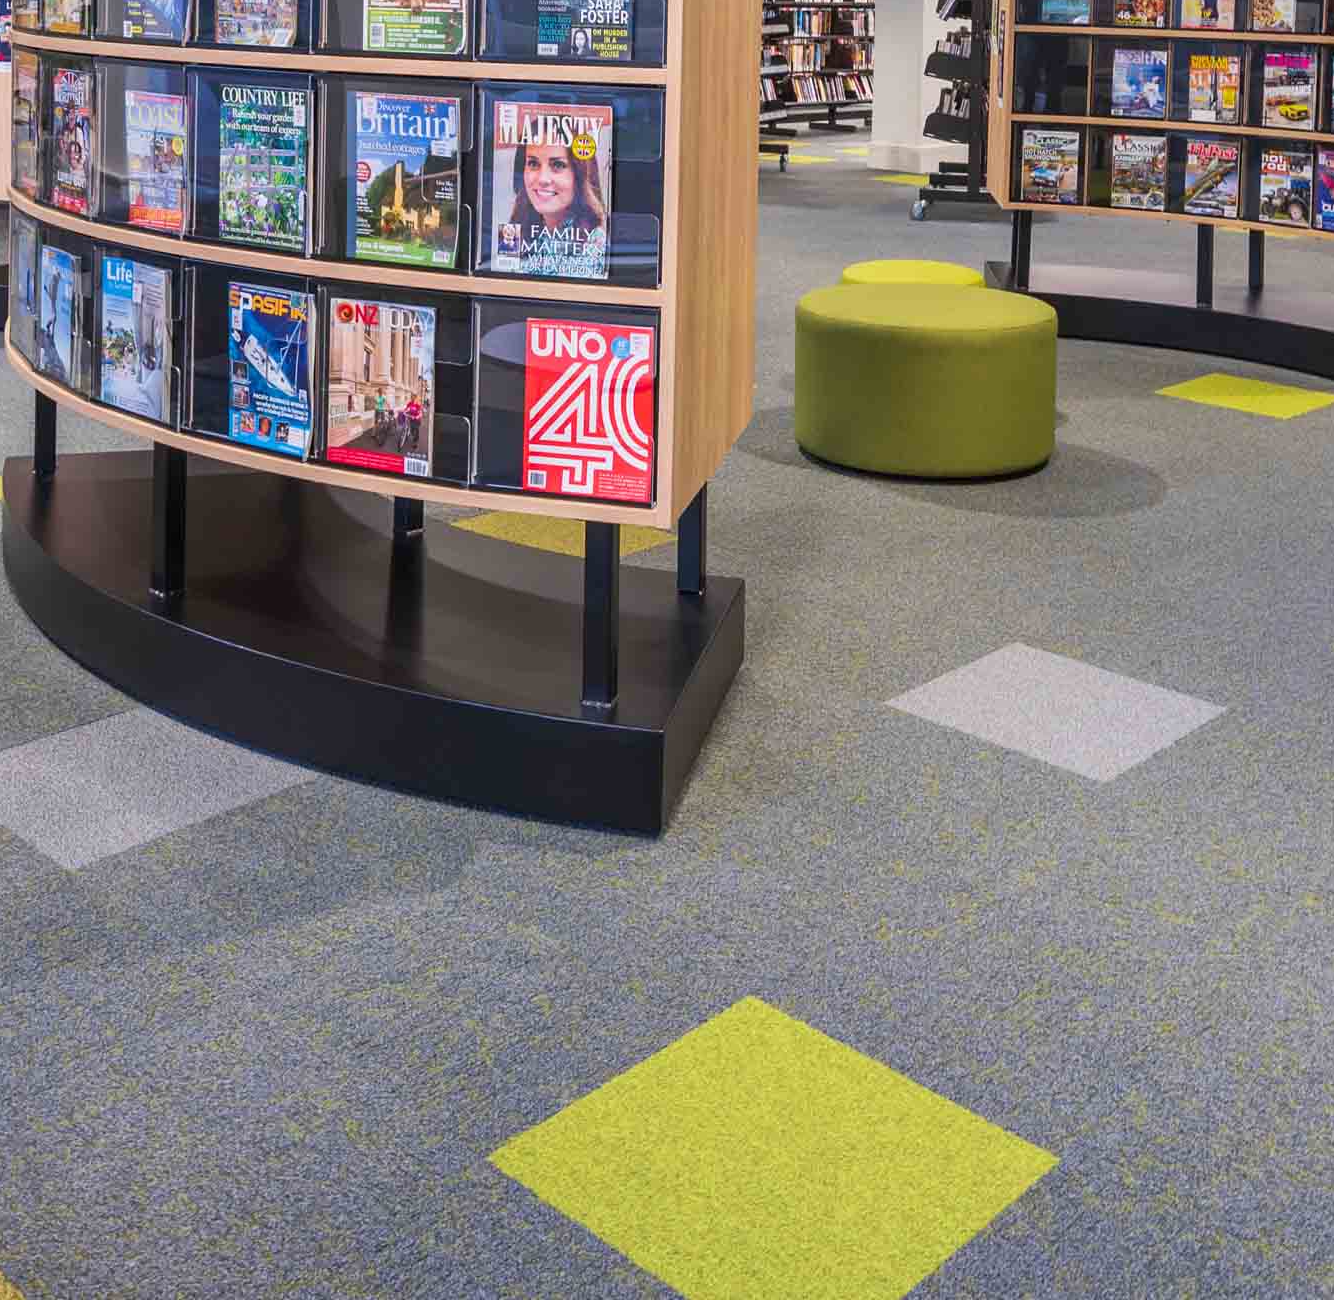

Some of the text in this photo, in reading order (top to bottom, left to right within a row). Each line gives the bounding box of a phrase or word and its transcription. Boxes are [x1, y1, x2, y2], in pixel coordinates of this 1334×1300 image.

[580, 10, 628, 25] FOSTER
[603, 29, 628, 37] MURDER
[592, 44, 628, 52] PUBLISHING
[222, 86, 306, 108] COUNTRY LIFE
[226, 122, 241, 130] with
[257, 111, 272, 123] your
[499, 112, 604, 148] MAJESTY
[530, 224, 596, 242] FAMILY
[521, 240, 604, 258] MATTERS
[106, 260, 134, 283] Life
[531, 327, 607, 361] UNO
